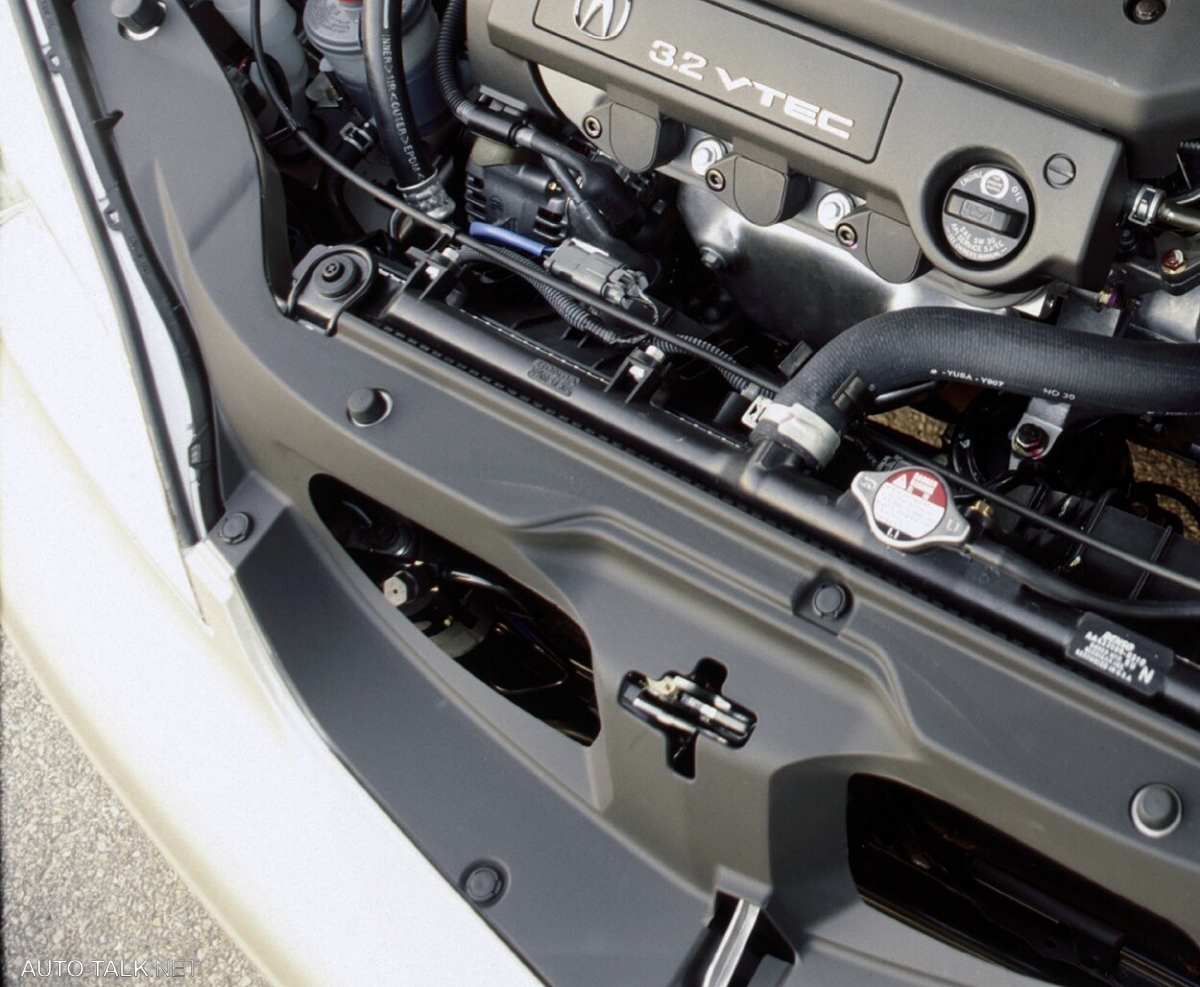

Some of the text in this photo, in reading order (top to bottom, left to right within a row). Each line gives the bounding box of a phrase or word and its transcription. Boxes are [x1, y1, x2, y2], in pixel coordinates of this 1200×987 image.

[649, 39, 854, 140] 3.2 VTEC
[959, 170, 983, 187] ENGINE
[1010, 185, 1023, 203] OIL
[1138, 666, 1155, 685] N
